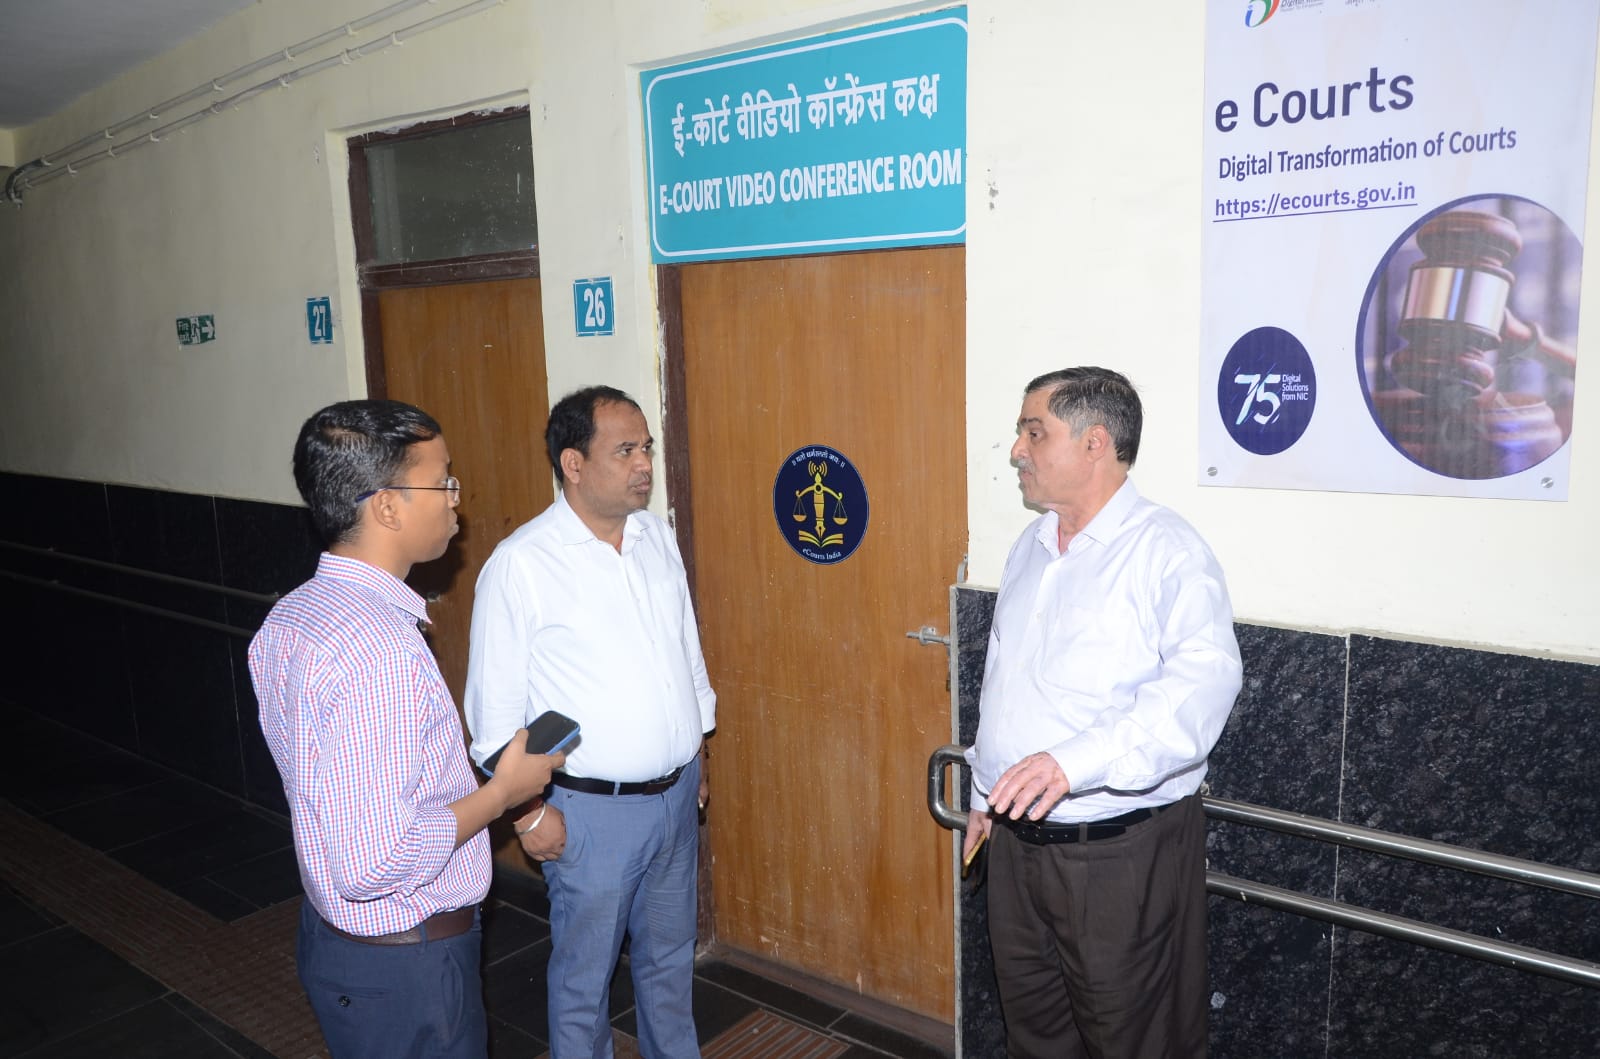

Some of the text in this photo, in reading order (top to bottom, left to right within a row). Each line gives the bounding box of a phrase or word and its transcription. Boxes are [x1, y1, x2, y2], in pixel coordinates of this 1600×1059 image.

[671, 95, 731, 157] ई-कोर्ट
[735, 83, 801, 140] वीडियो
[892, 73, 940, 119] कक्ष
[1215, 67, 1414, 132] e Courts
[1219, 127, 1517, 182] Digital Transformation of Courts
[660, 148, 962, 215] E-COURT VIDEO CONFERENCE ROOM
[1215, 182, 1416, 217] https://ecourts.gov.in
[313, 305, 326, 337] 27
[583, 287, 606, 327] 26
[1282, 374, 1301, 385] Digital
[1282, 383, 1309, 392] Solutions
[1282, 392, 1309, 402] from NIC
[1234, 373, 1280, 425] 75
[802, 548, 841, 560] eCourts India
